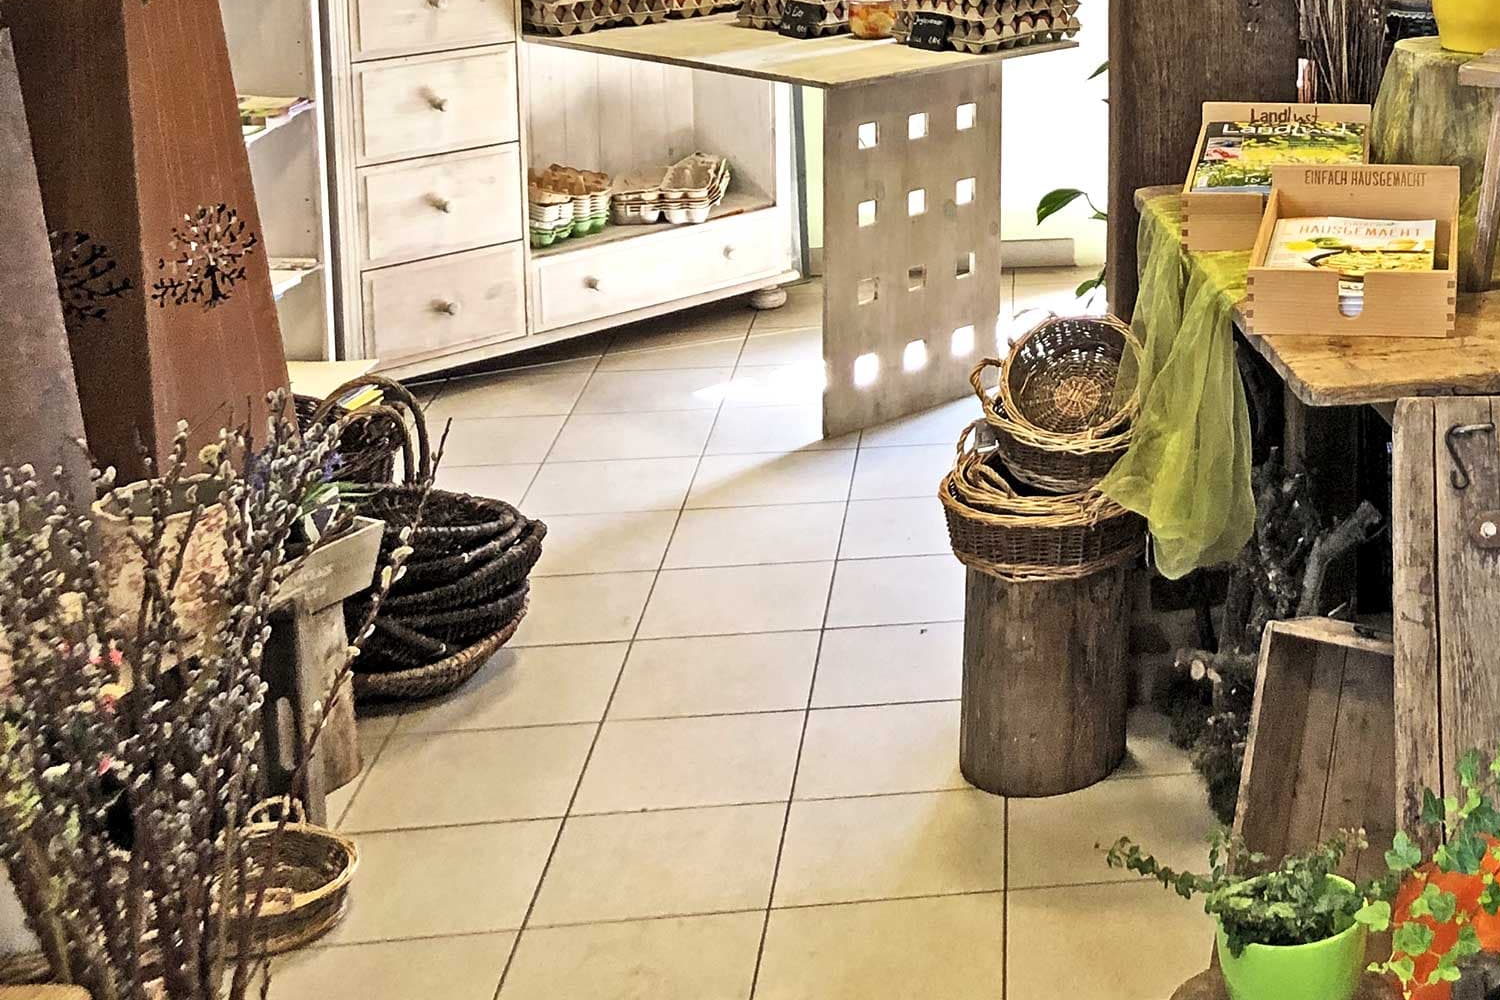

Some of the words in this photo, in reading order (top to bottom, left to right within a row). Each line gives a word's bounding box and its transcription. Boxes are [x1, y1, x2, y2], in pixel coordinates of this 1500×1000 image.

[1250, 106, 1320, 125] Landlust
[1222, 121, 1347, 137] Landlust
[1304, 169, 1348, 185] EINFACH
[1351, 170, 1427, 187] HAUSGEMACHT
[1299, 223, 1422, 238] HAUSGEMACHT
